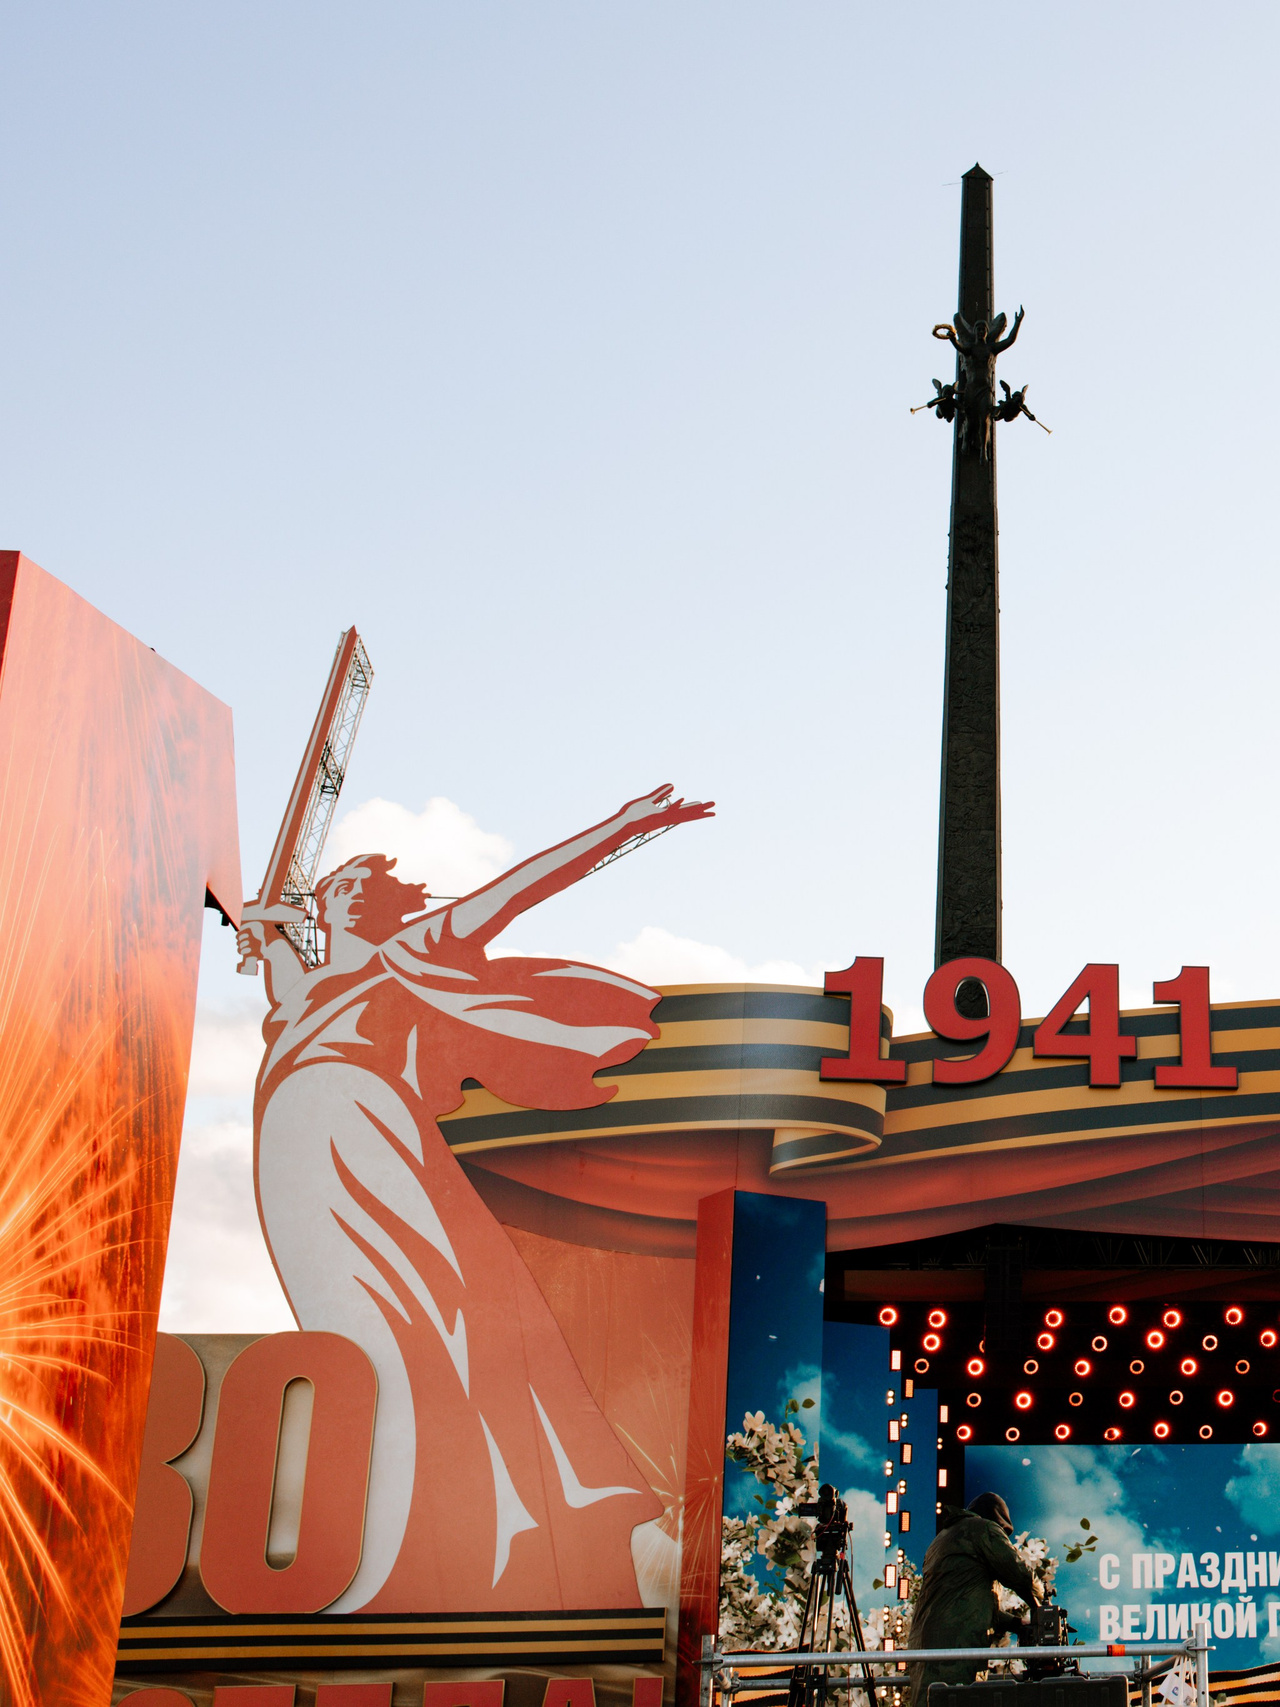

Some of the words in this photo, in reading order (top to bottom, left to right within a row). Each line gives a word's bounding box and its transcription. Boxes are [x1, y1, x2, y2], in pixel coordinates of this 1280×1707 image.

[819, 956, 1239, 1090] 1941
[1099, 1553, 1120, 1590] С
[1100, 1595, 1257, 1641] ВЕЛИКОЙ
